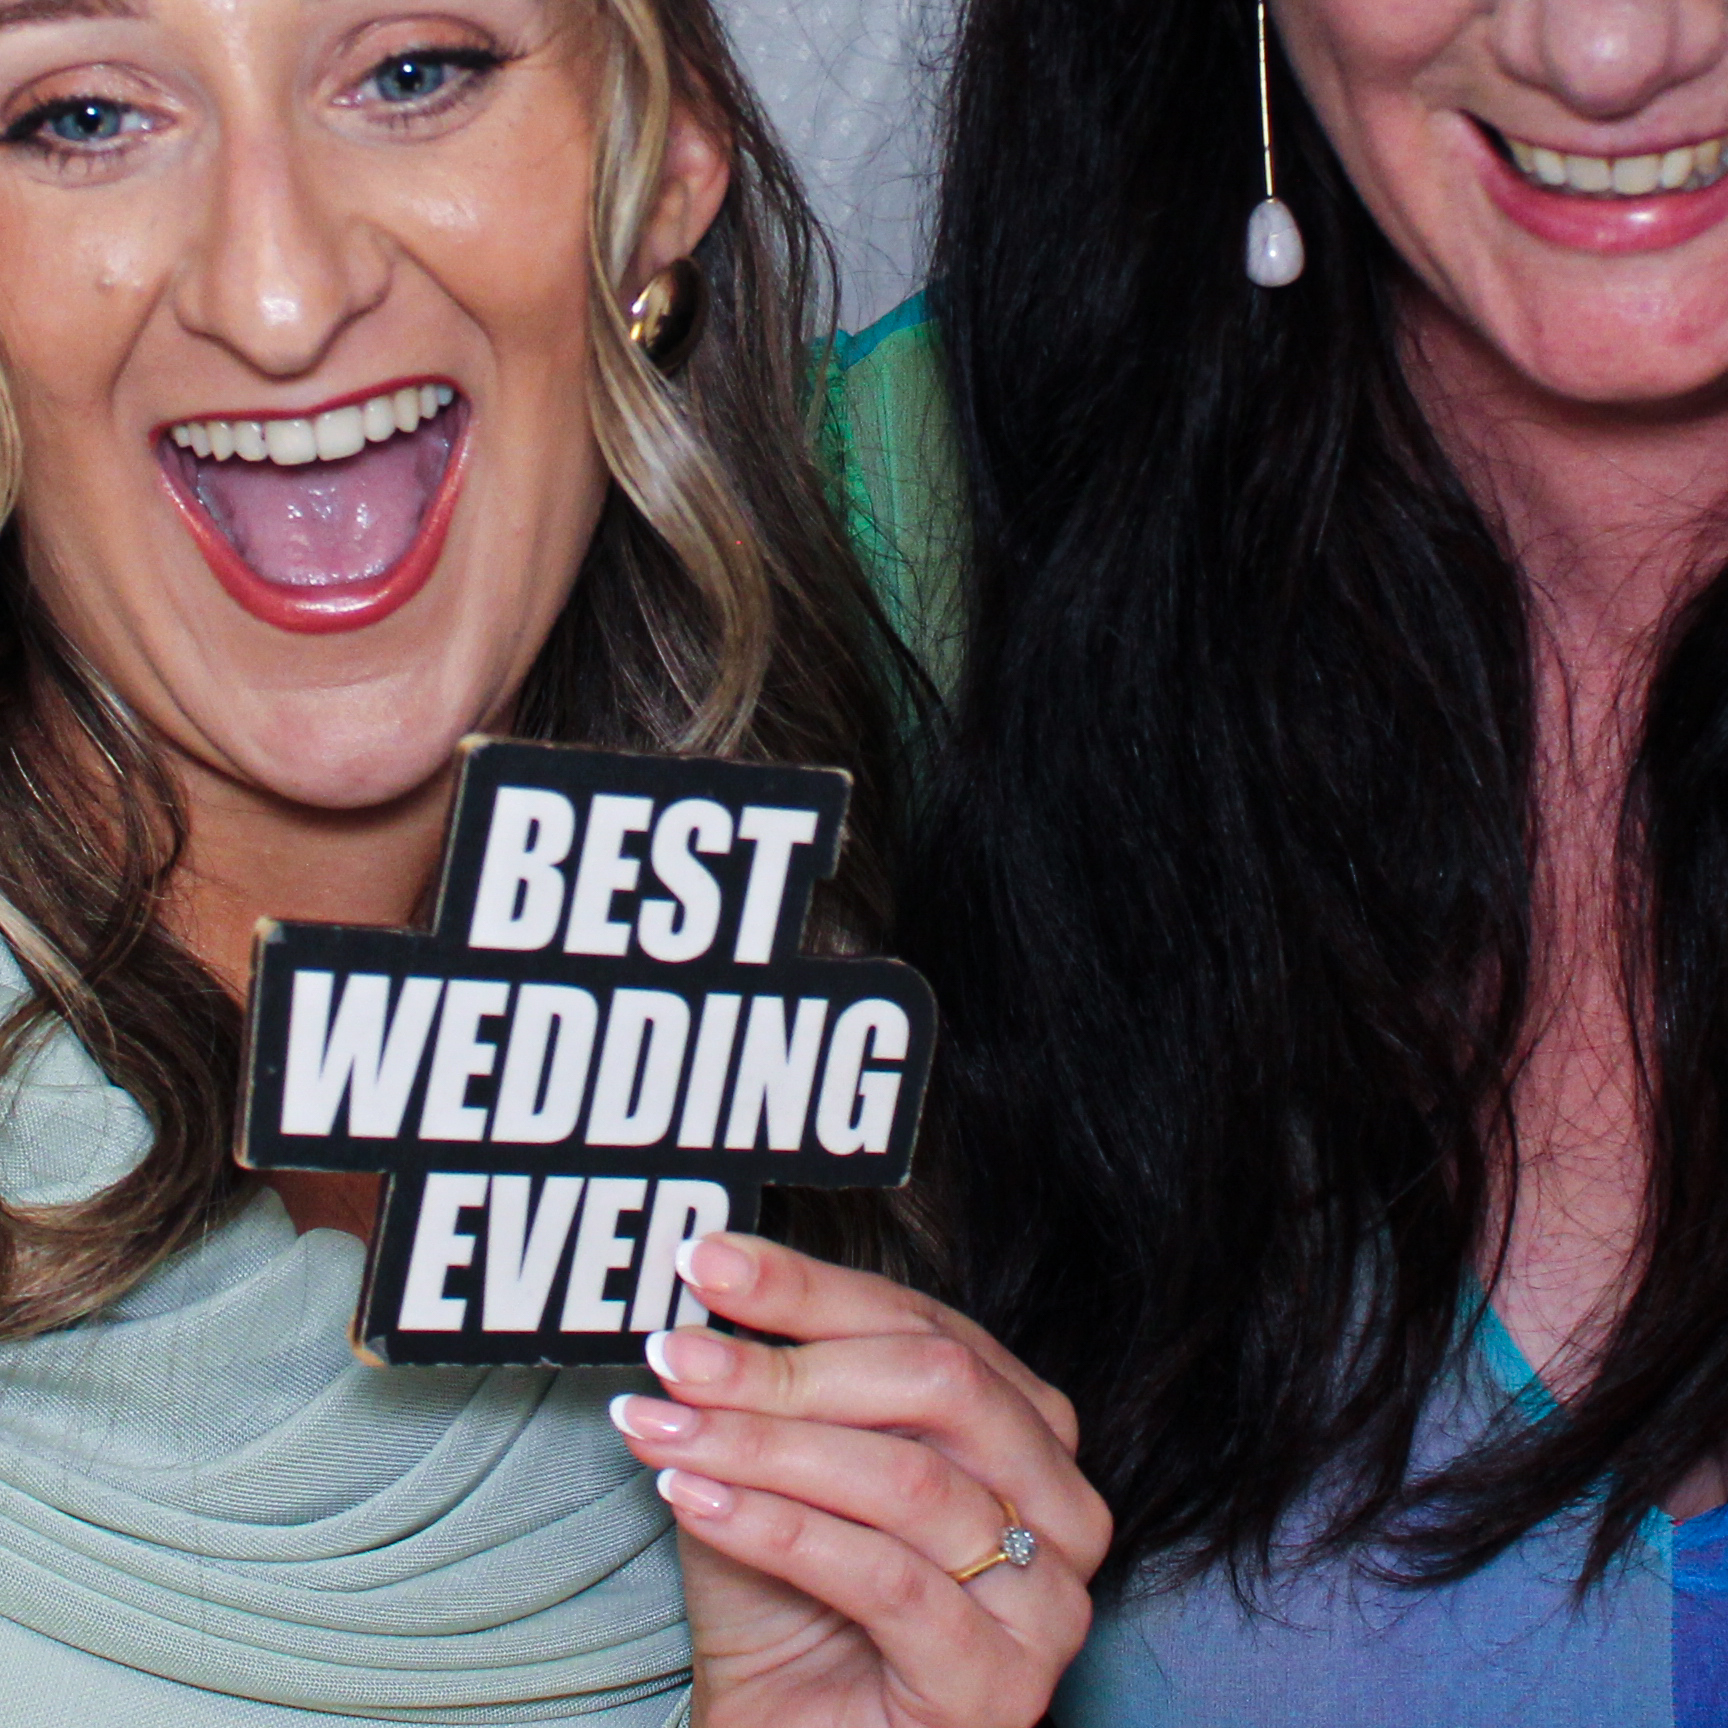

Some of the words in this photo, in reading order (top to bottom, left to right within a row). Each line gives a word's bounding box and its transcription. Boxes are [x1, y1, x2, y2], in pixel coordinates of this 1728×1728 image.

[468, 785, 819, 965] BEST
[279, 969, 910, 1157] WEDDING
[397, 1172, 731, 1334] EVER
